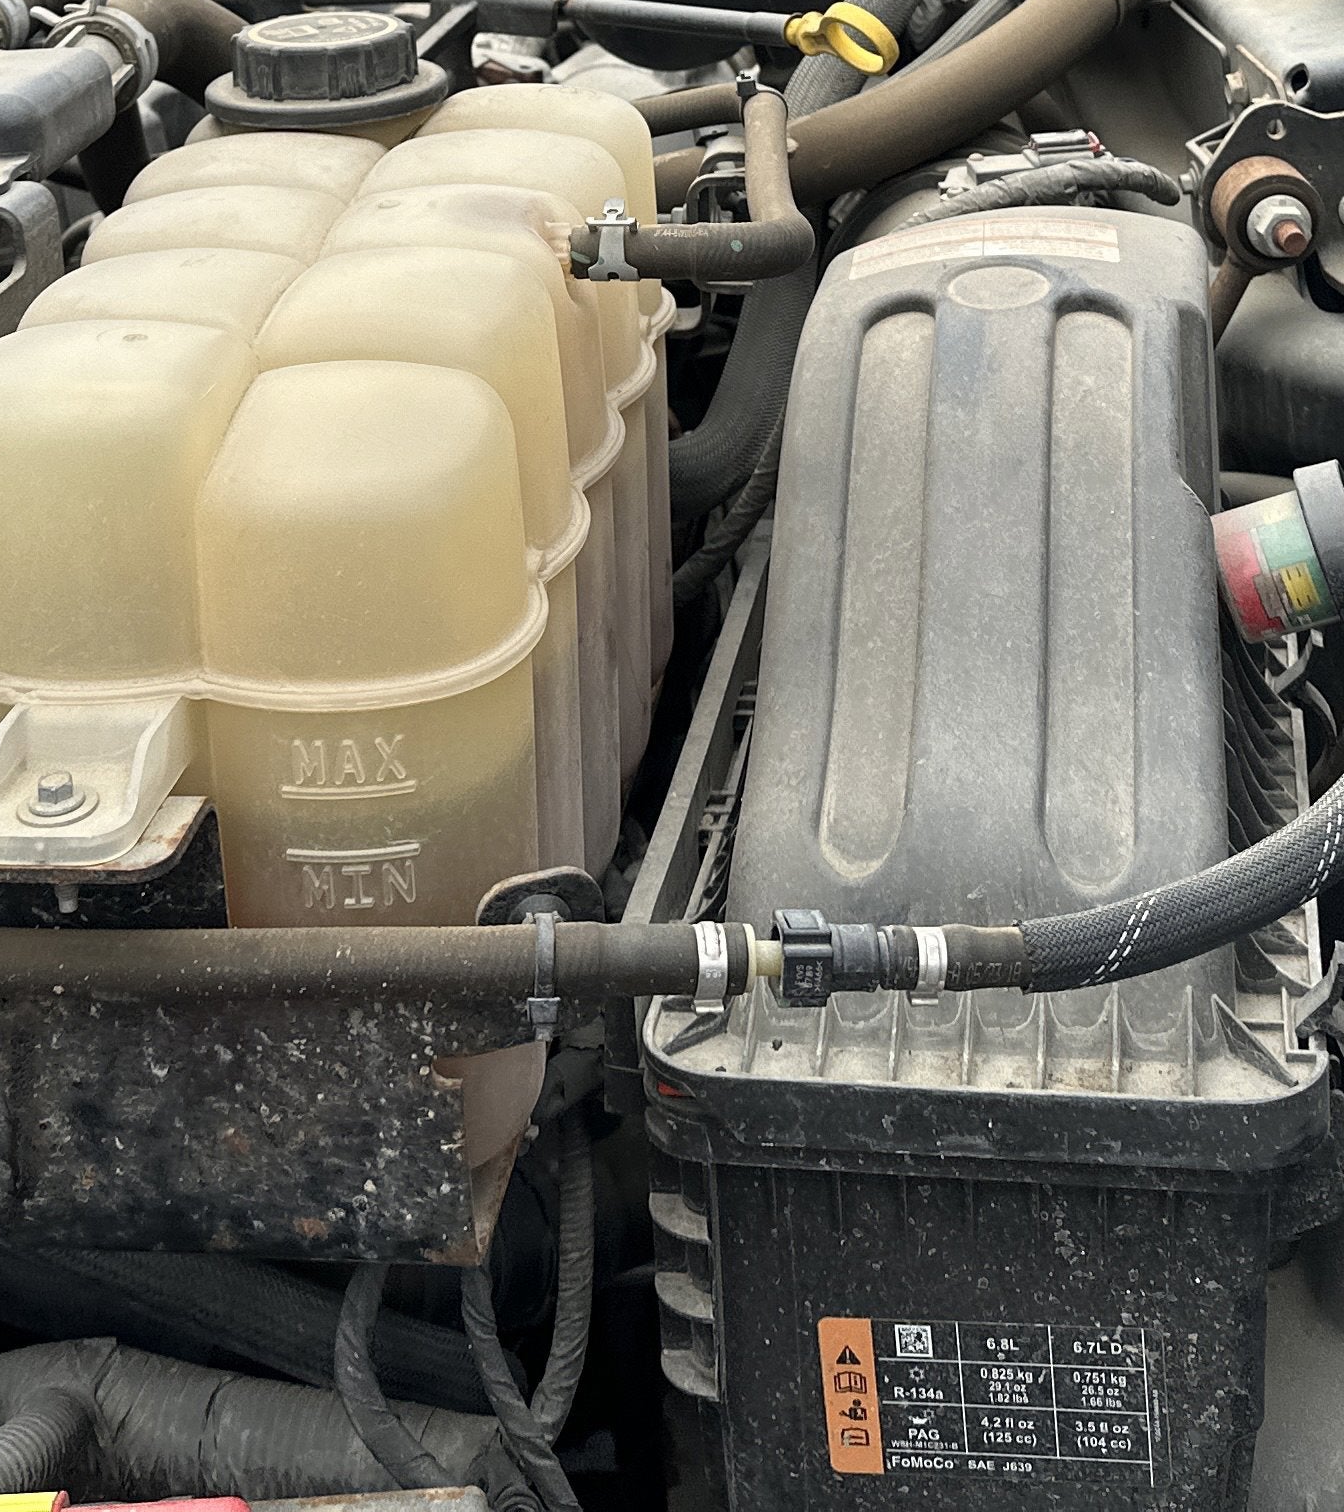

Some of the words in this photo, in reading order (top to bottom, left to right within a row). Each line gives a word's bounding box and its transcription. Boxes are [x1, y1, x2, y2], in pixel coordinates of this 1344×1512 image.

[290, 734, 408, 785] MAX
[302, 858, 417, 909] MIN
[986, 1337, 1020, 1351] 6.8L
[1073, 1341, 1106, 1355] 6.7L
[1110, 1342, 1122, 1355] D
[980, 1367, 1014, 1380] 0.825
[1017, 1368, 1033, 1384] kg
[1073, 1371, 1106, 1384] 0.751
[1110, 1372, 1127, 1388] kg
[893, 1387, 944, 1400] R-134a
[1013, 1383, 1027, 1393] oz
[1106, 1388, 1120, 1397] oz
[908, 1428, 940, 1441] PAG
[1017, 1420, 1035, 1430] oz
[1075, 1421, 1095, 1433] 3.5
[1112, 1425, 1129, 1434] oz
[983, 1431, 1012, 1444] (125
[1015, 1433, 1037, 1448] cc)
[1077, 1436, 1106, 1449] (104
[1110, 1438, 1132, 1452] cc)
[891, 1455, 954, 1469] FoMoCo
[967, 1459, 996, 1471] SAE
